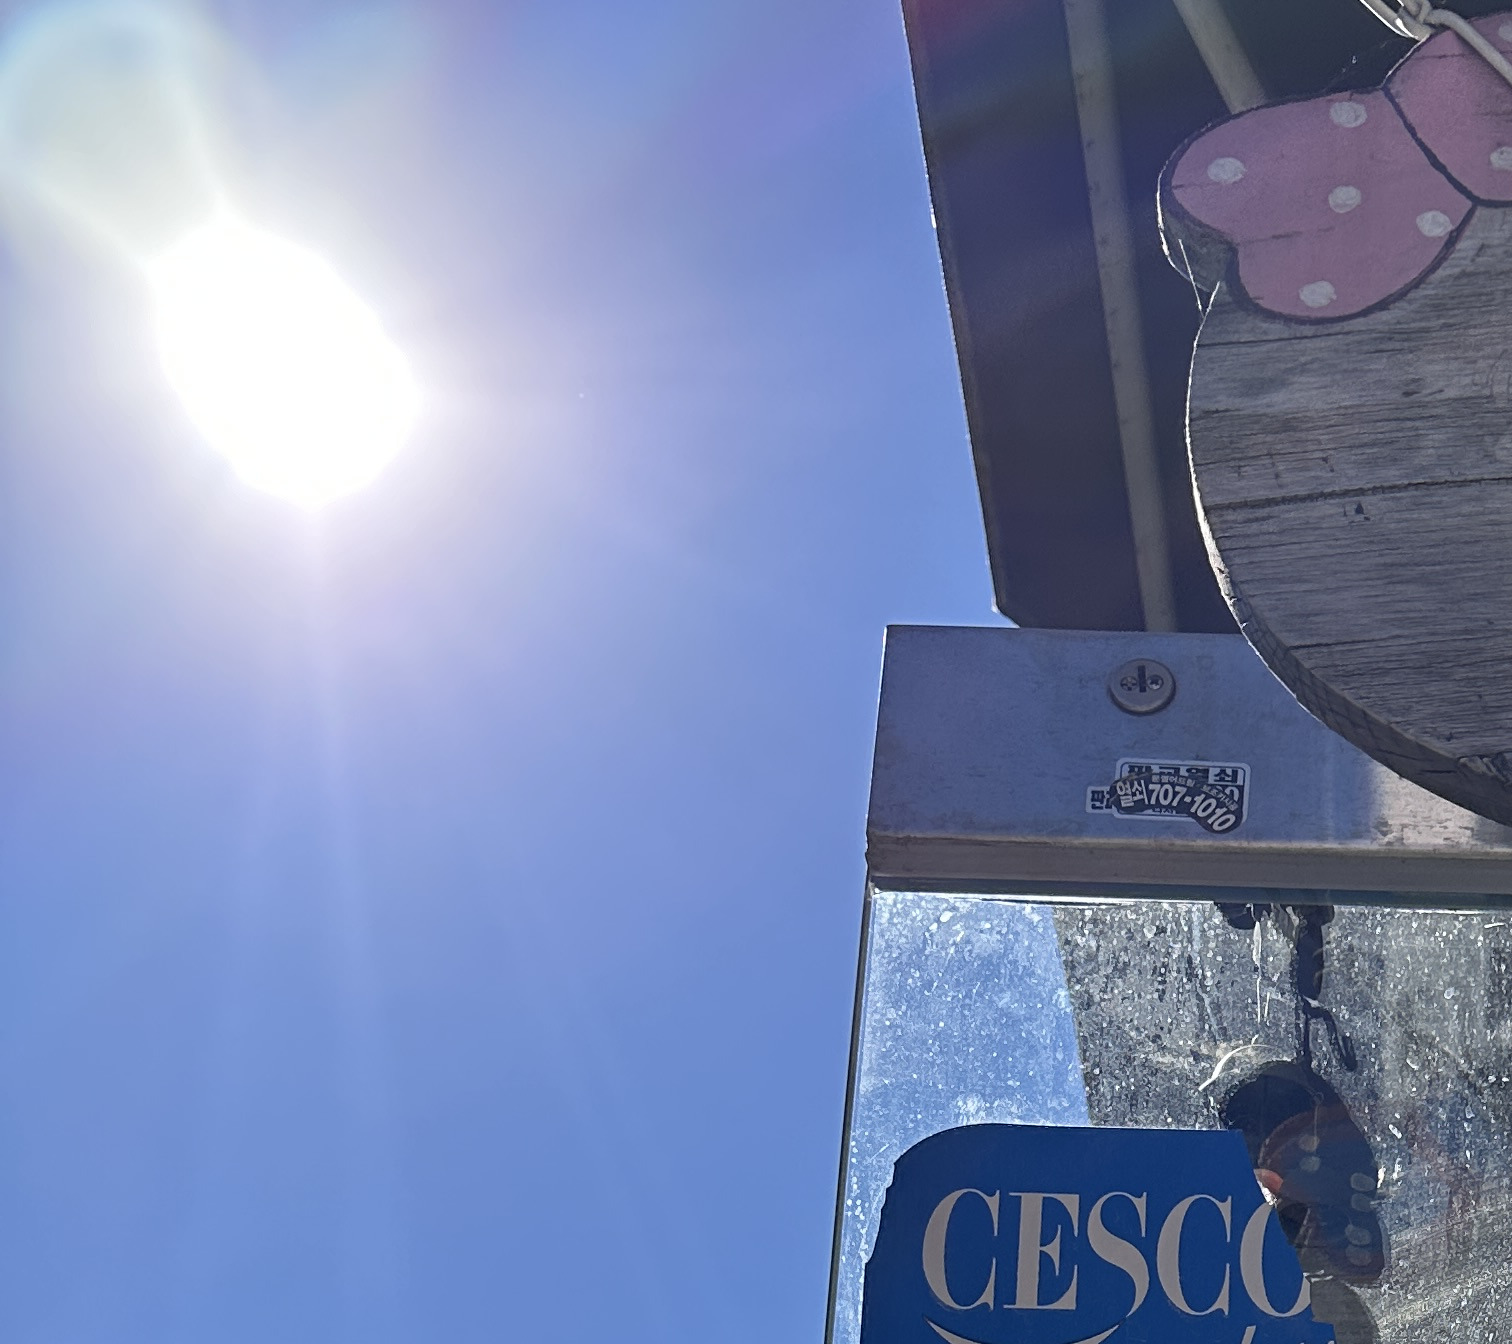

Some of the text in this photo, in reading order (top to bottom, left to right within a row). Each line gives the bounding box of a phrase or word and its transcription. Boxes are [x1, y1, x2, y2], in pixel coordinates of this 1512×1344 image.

[1116, 779, 1149, 808] 열쇠
[1149, 784, 1237, 831] 707-1010
[922, 1187, 1313, 1320] CESCO
